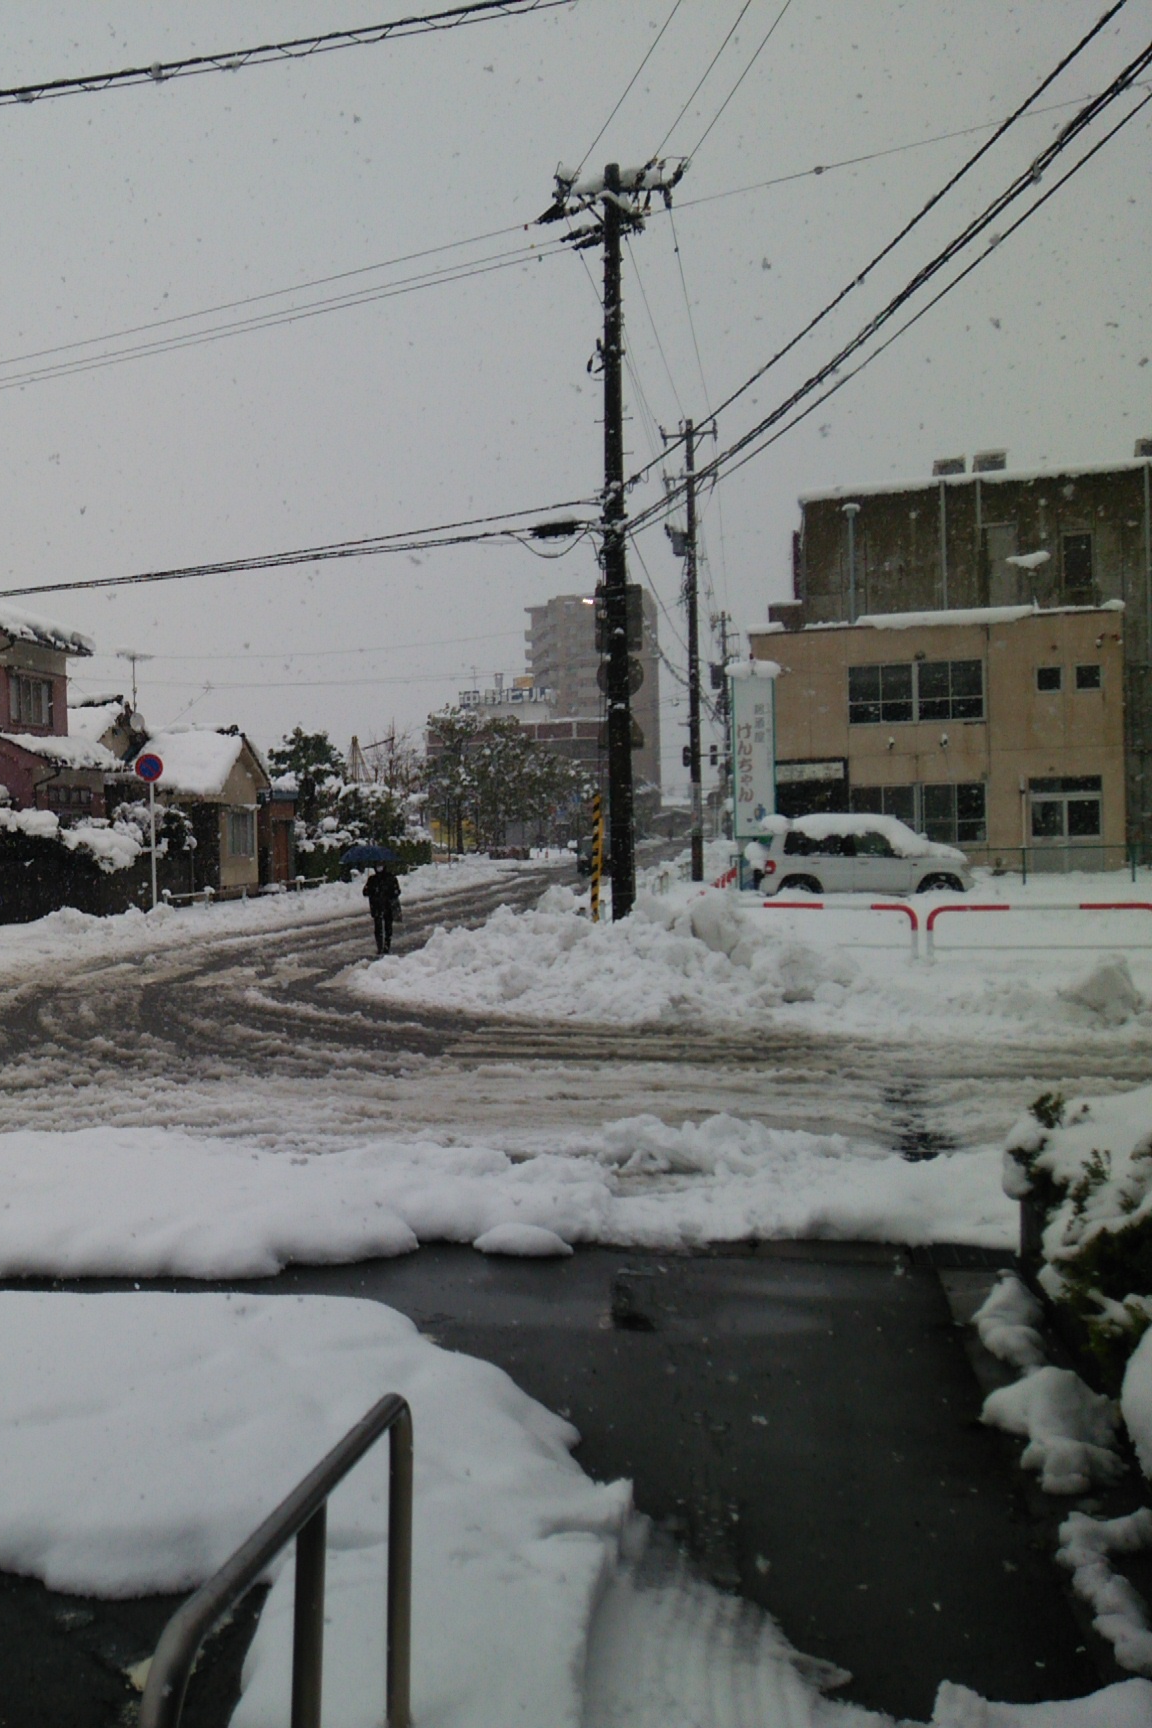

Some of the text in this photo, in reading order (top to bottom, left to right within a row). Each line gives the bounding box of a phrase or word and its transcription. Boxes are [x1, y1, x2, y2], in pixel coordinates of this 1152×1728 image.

[737, 723, 755, 803] けんちゃん
